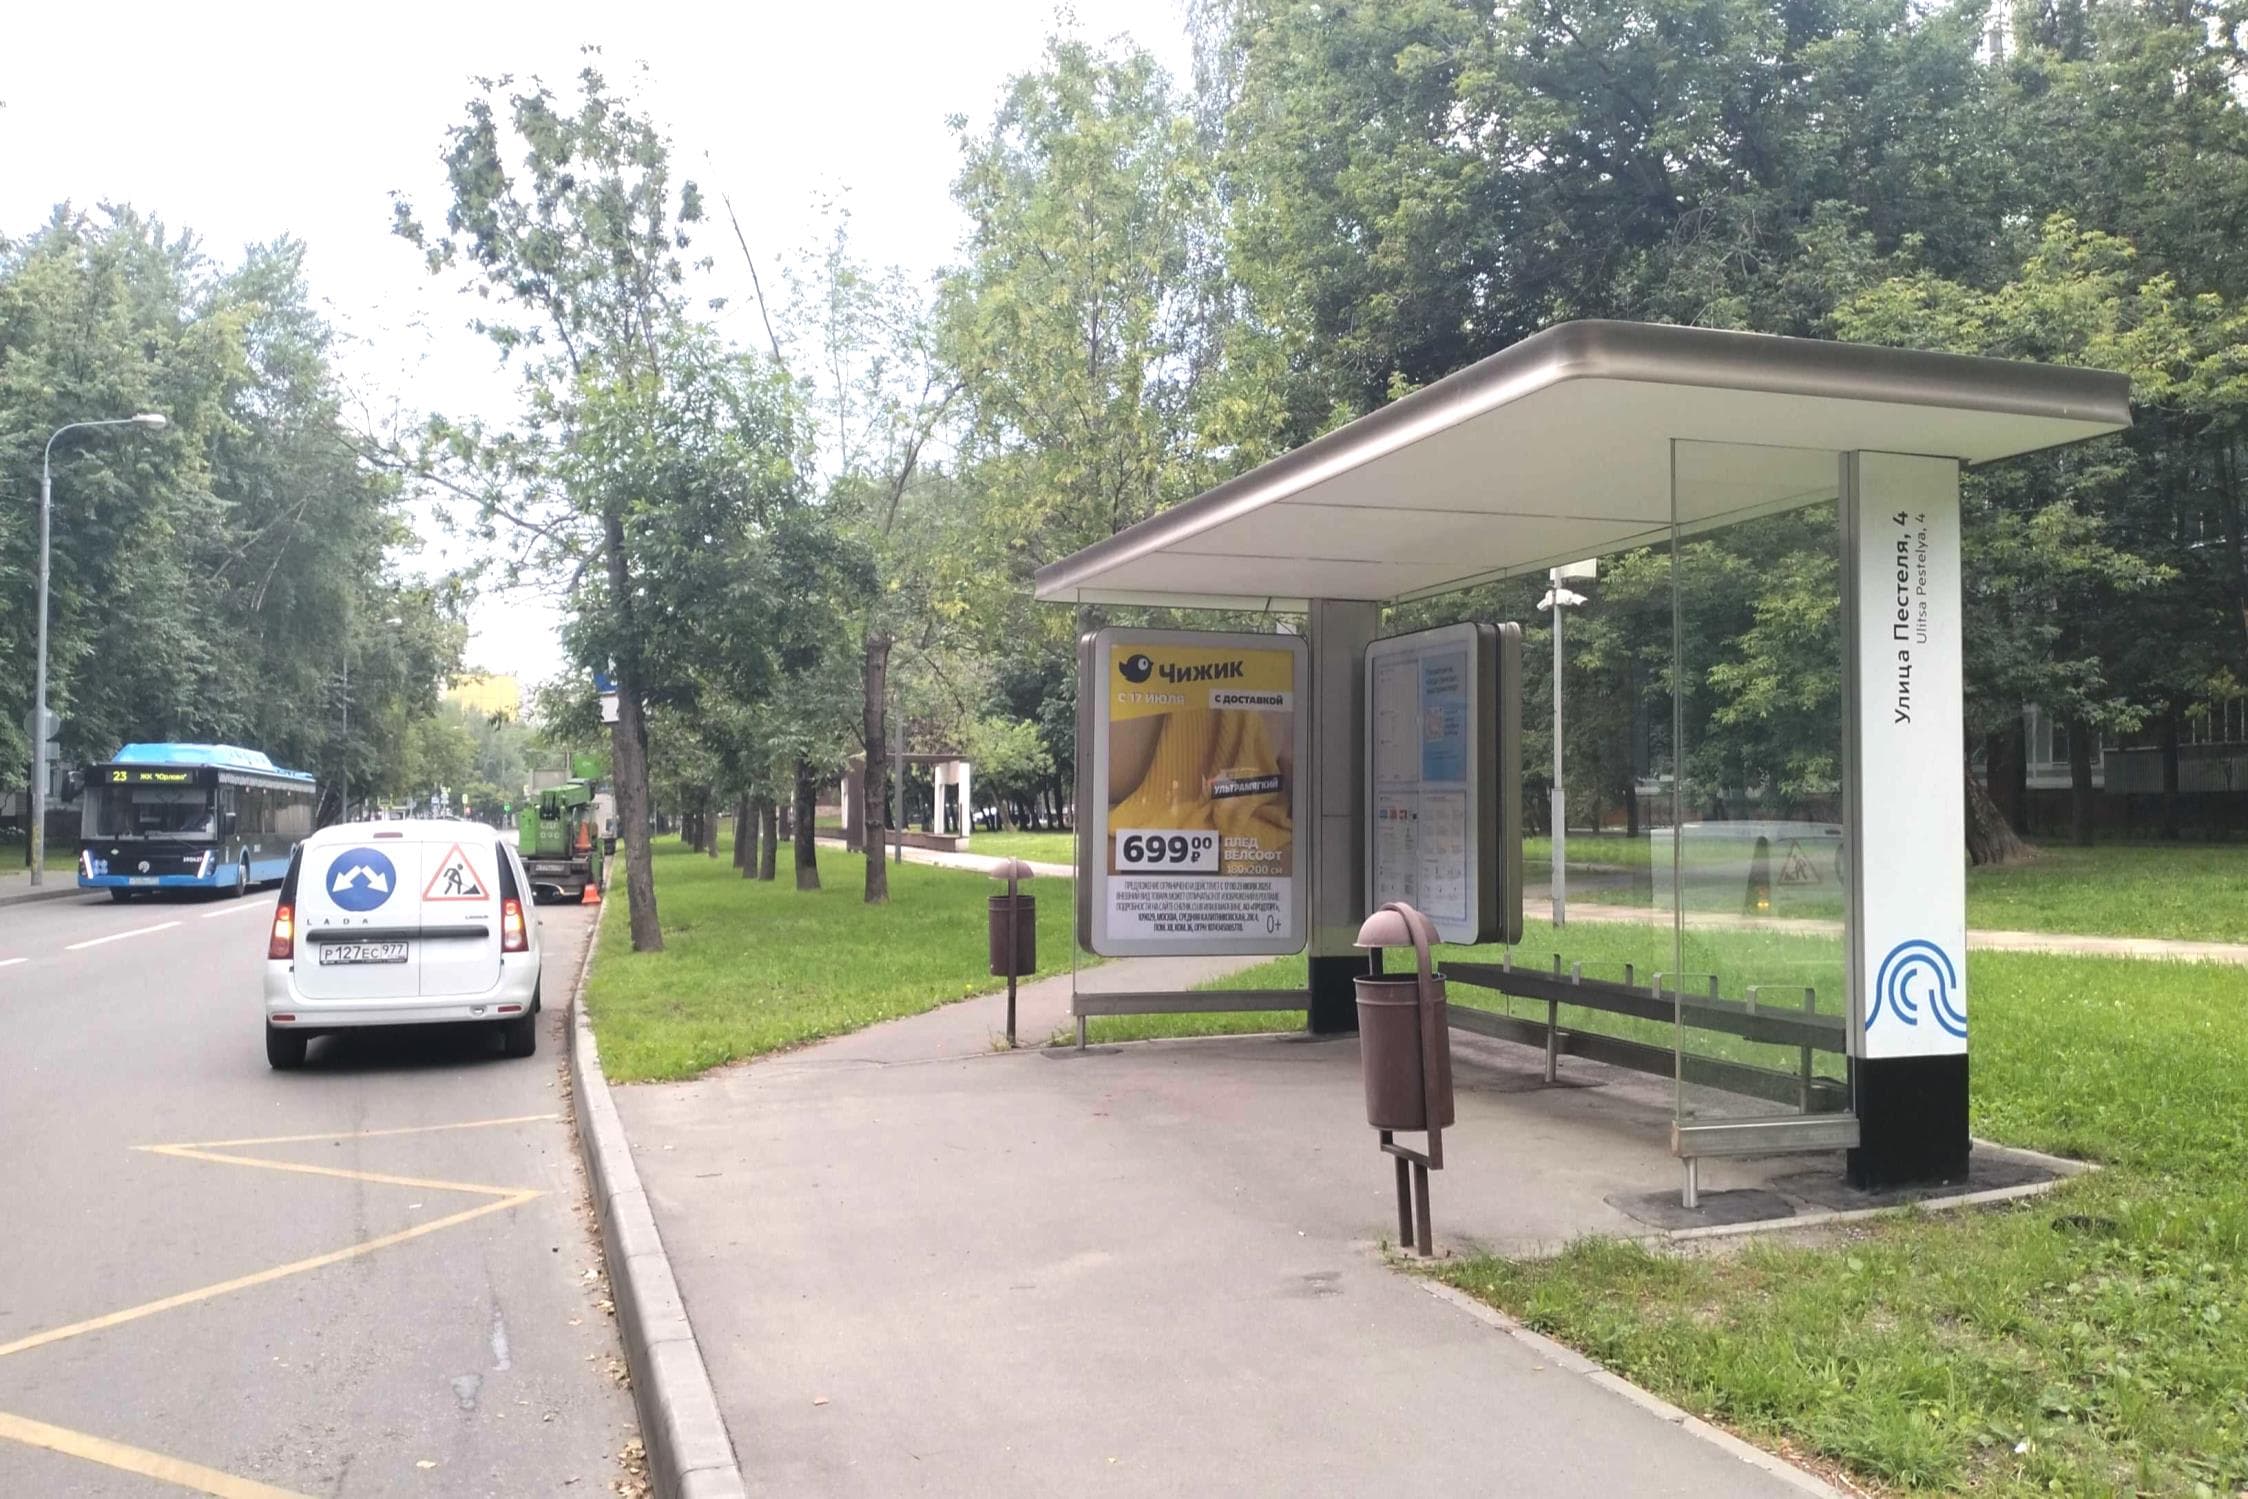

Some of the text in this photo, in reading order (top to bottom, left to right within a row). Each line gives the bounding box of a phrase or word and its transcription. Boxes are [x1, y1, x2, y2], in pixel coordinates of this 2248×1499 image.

[1915, 512, 1928, 644] Ulitsa Pestelya, 4
[1893, 511, 1911, 724] Улица Пестеля, 4
[1129, 691, 1142, 704] 17
[1145, 692, 1185, 705] ИЮЛЯ
[1223, 694, 1283, 705] ДОСТАВКОЙ
[112, 771, 128, 782] 23
[1214, 779, 1279, 795] УЛЬТРАМЯГКИЙ
[1123, 835, 1212, 864] 699 00
[1224, 837, 1259, 849] ПЛЕД
[1224, 850, 1283, 862] ВЕЛСОФТ
[306, 918, 368, 926] LADA
[1266, 914, 1281, 934] 0+
